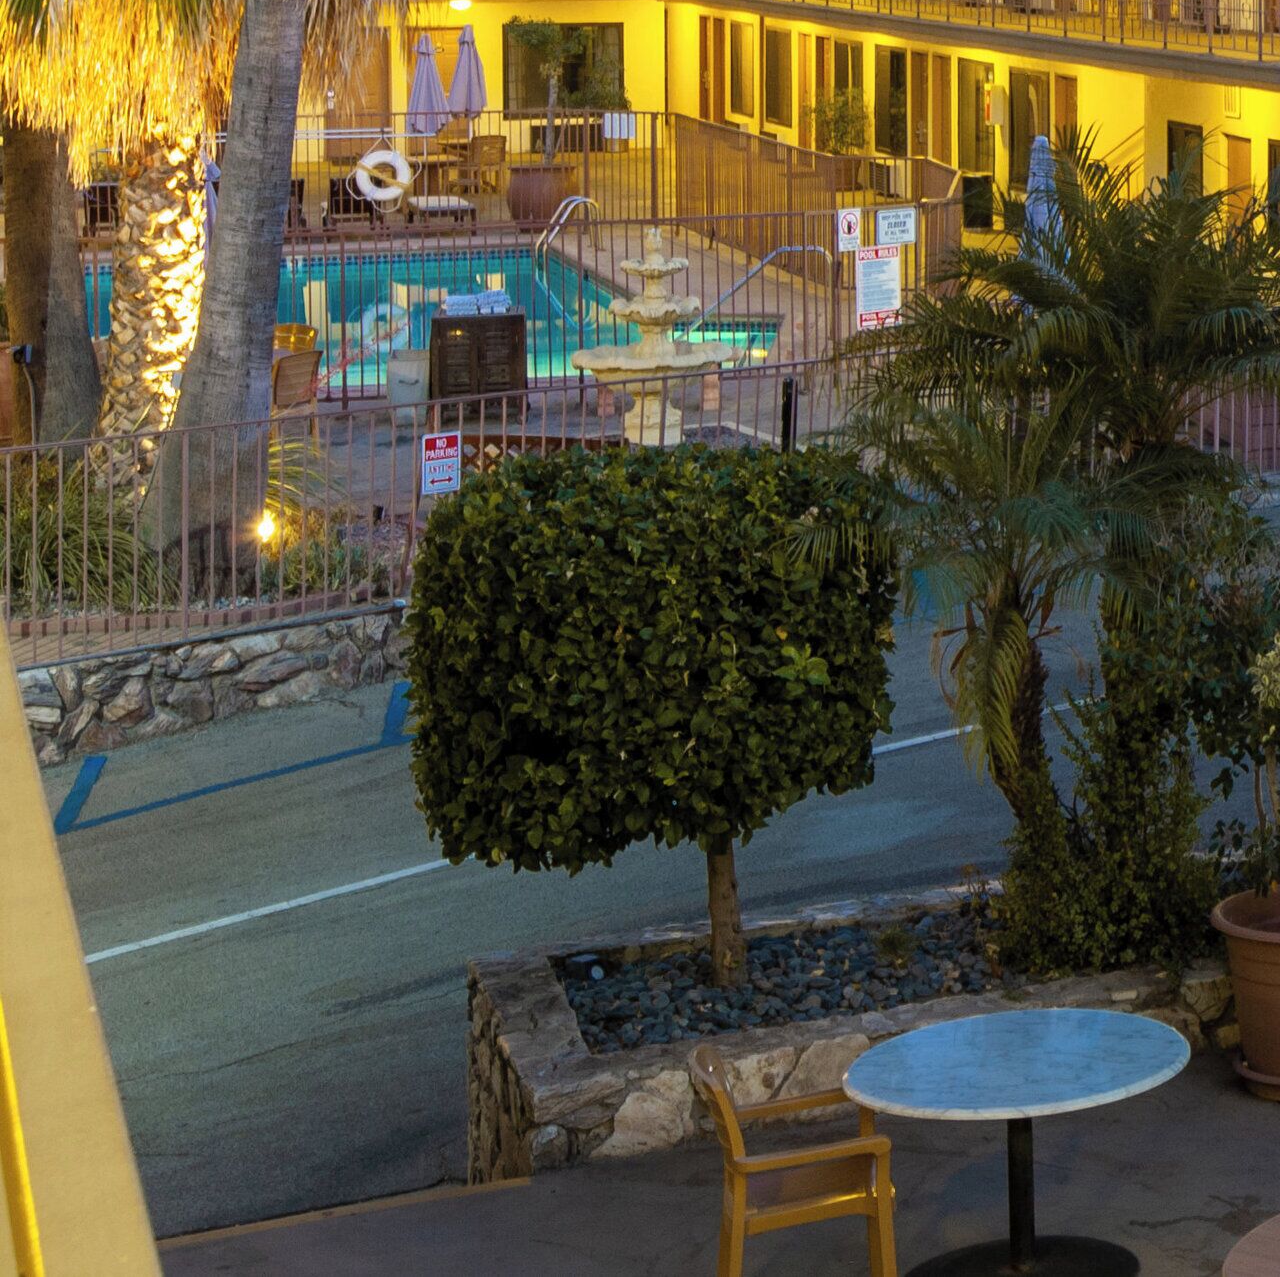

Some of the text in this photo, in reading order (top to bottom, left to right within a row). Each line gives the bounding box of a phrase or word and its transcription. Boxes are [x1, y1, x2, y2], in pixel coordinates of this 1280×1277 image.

[859, 248, 898, 260] POOL RULES
[425, 437, 458, 460] NO PARKING
